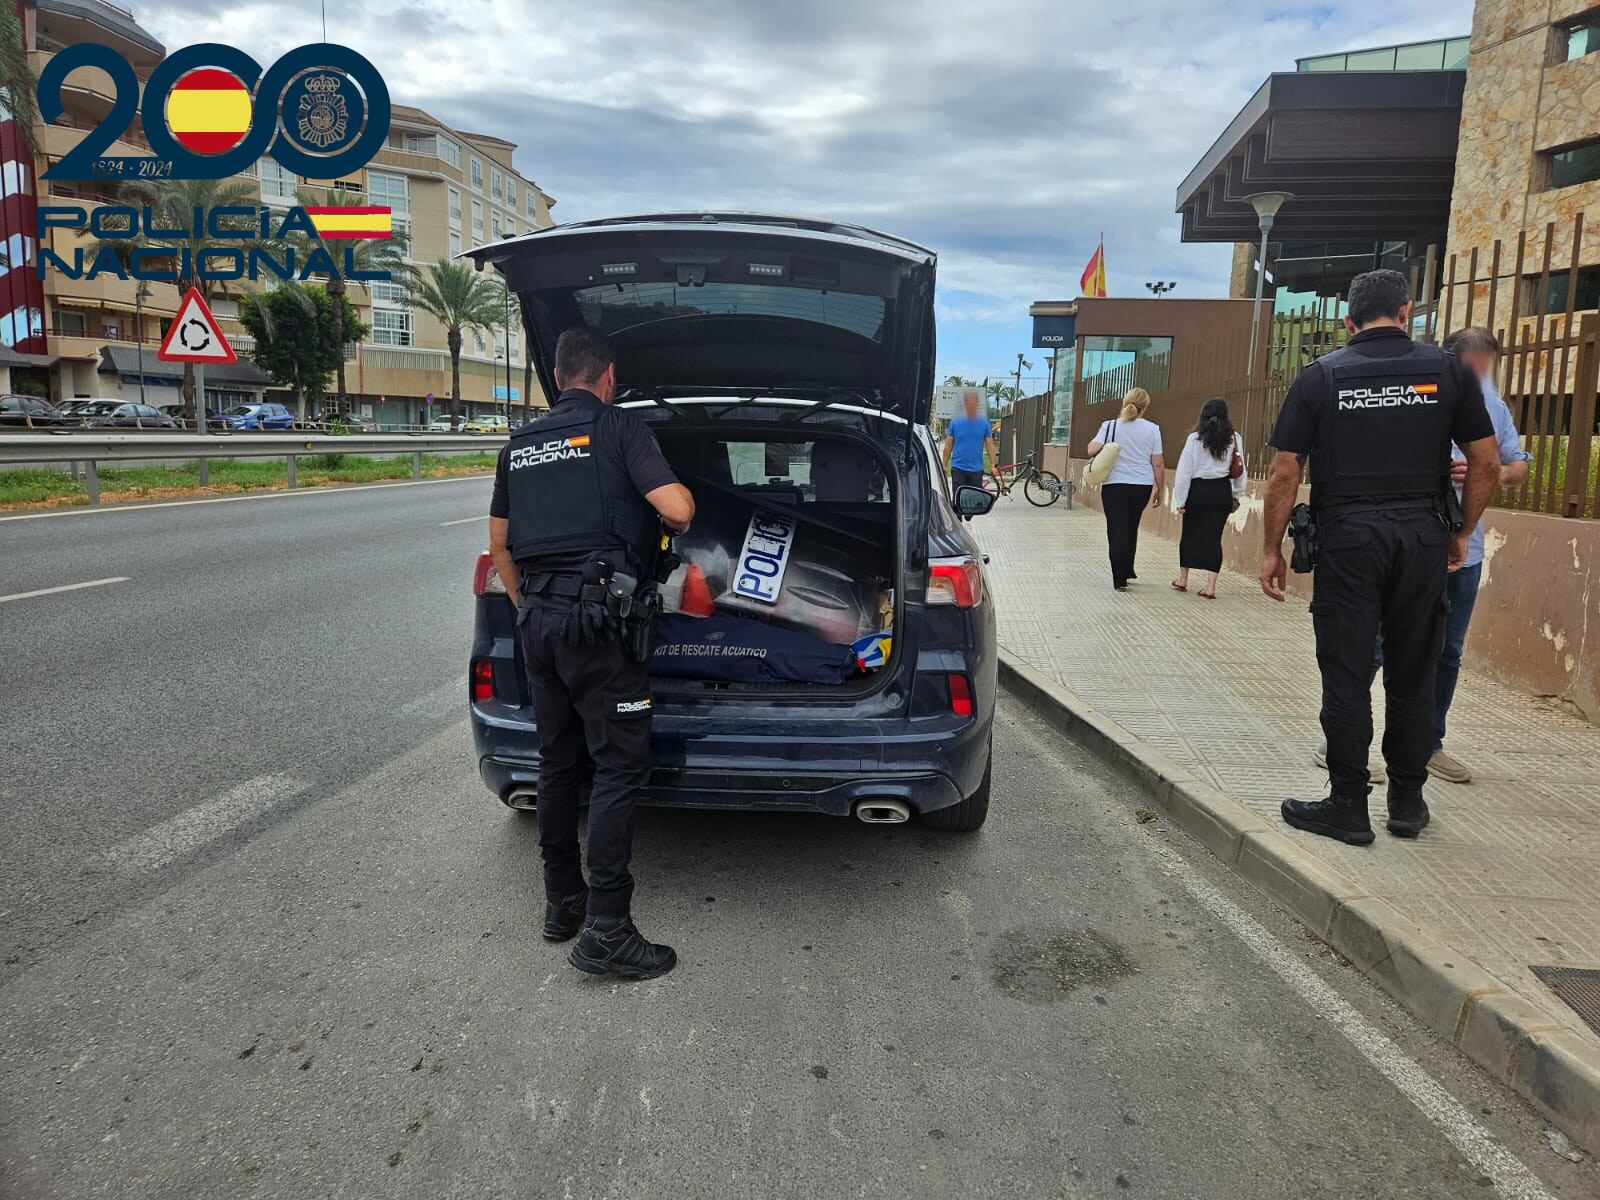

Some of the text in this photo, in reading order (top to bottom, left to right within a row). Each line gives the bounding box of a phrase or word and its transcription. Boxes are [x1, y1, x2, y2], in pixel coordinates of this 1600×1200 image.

[1339, 386, 1417, 399] POLICIA
[1339, 395, 1438, 410] NACIONAL
[510, 438, 572, 460] POLICIA
[510, 448, 590, 471] NACIONAL
[654, 645, 767, 658] KIT DE RESCATE ACUATICO
